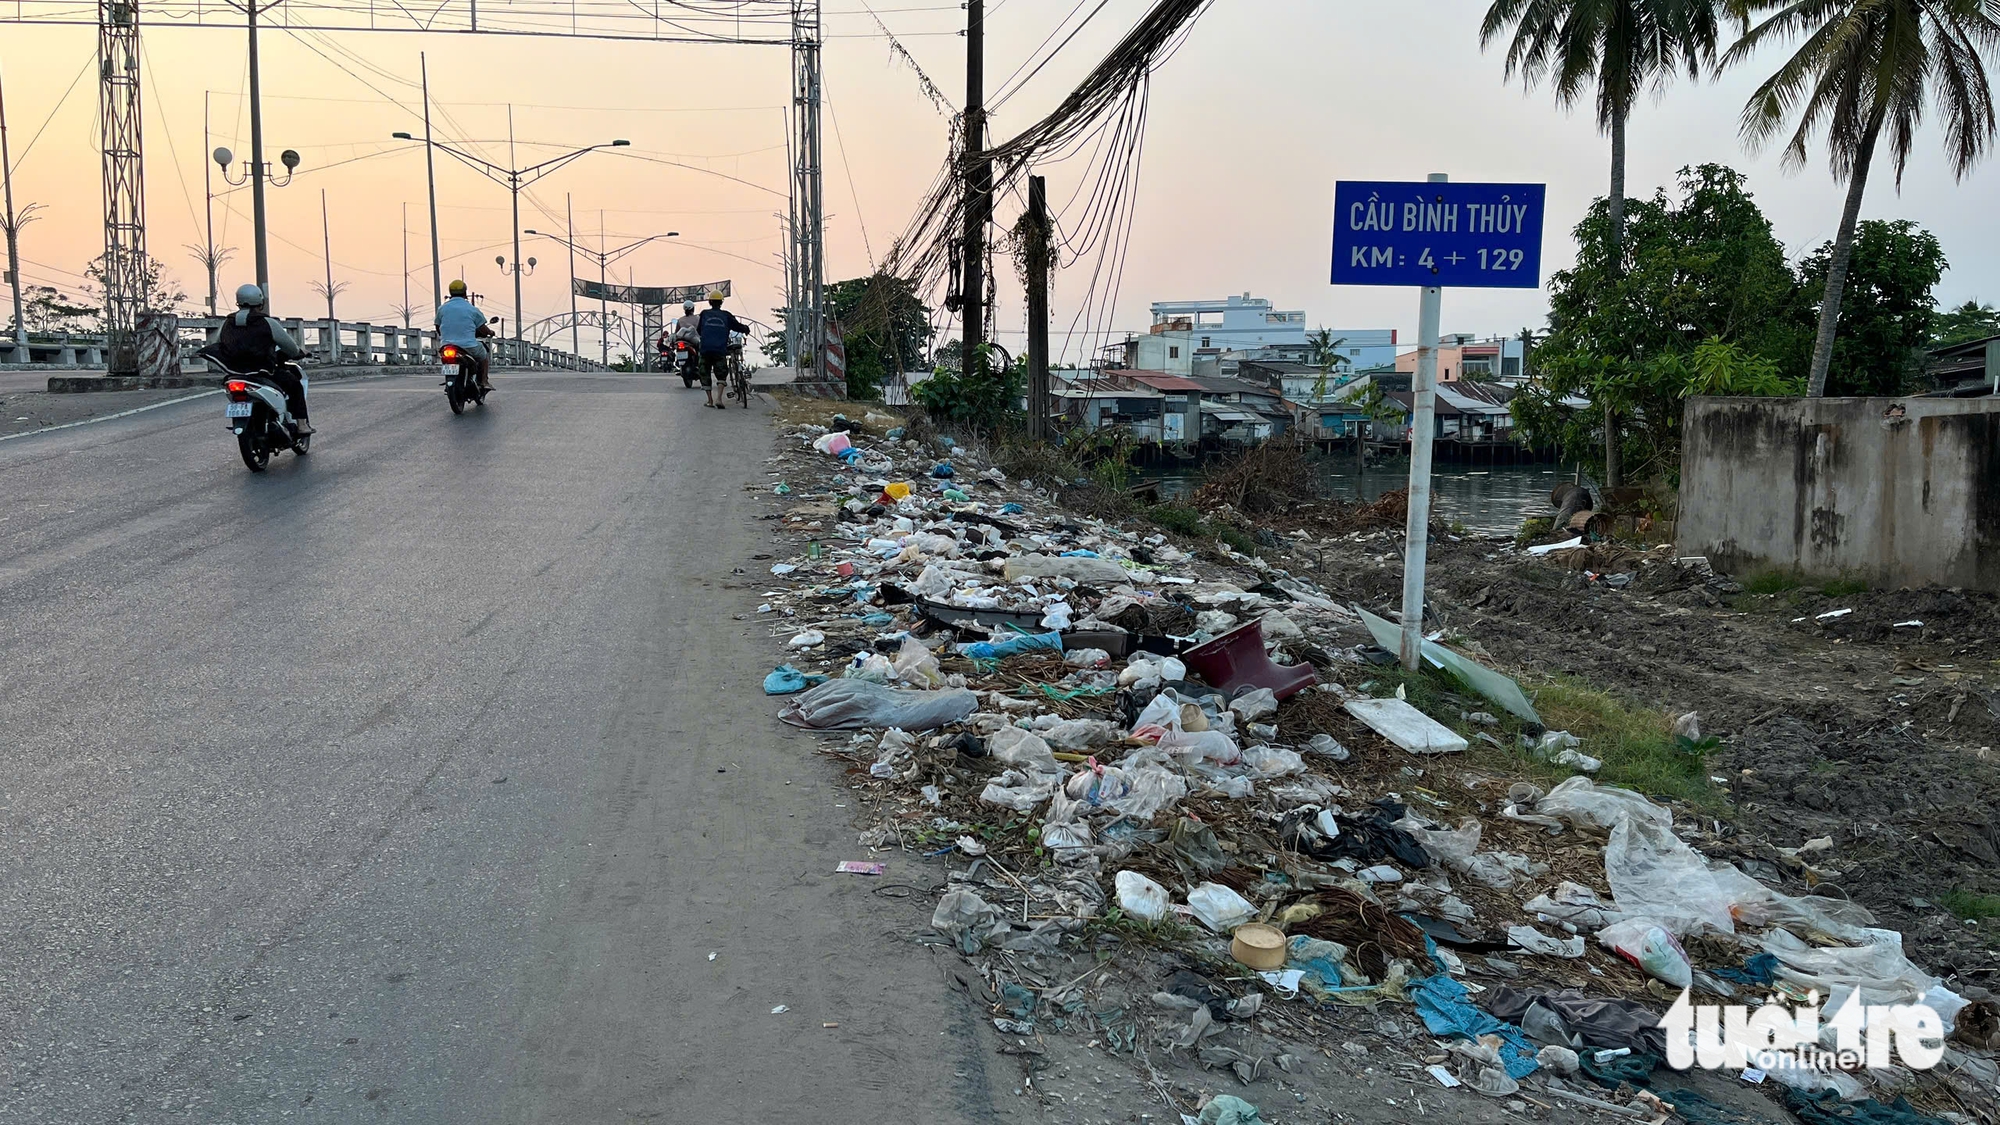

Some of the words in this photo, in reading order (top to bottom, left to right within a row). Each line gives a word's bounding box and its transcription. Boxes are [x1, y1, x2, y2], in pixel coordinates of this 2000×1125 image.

[1350, 191, 1394, 231] CẦU
[1402, 195, 1458, 232] BÌNH
[1466, 194, 1528, 234] THỦY
[1351, 245, 1405, 269] KM:
[1418, 247, 1435, 269] 4
[1477, 248, 1524, 271] 129
